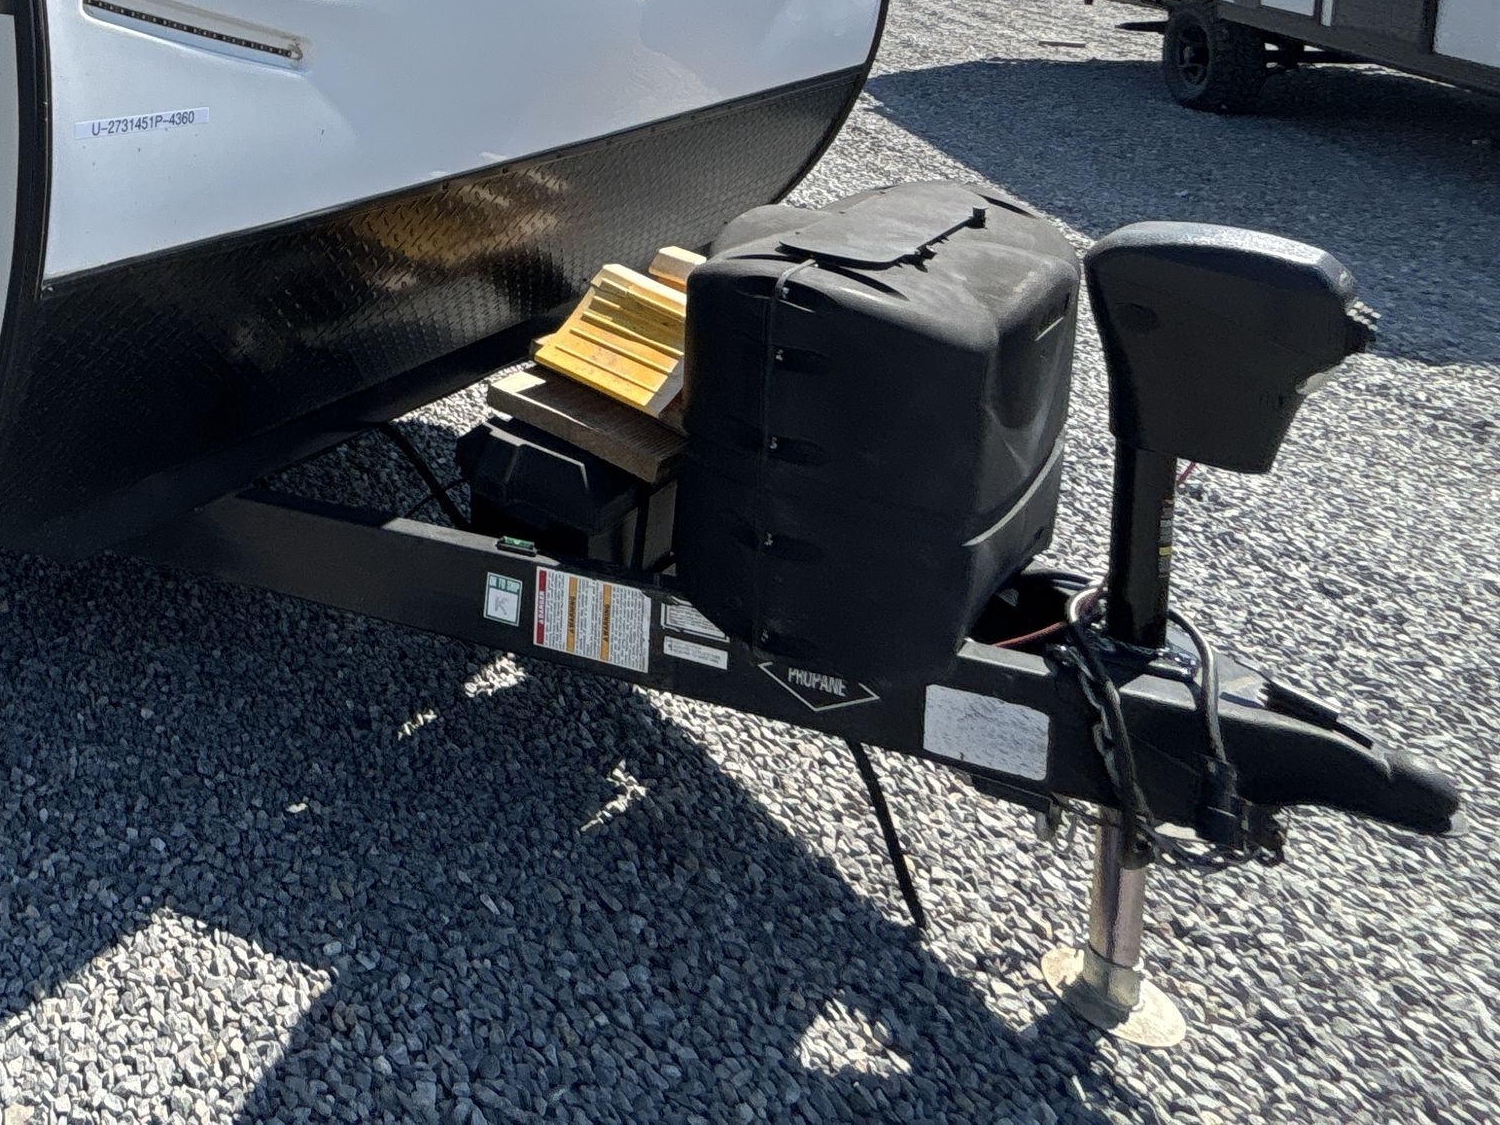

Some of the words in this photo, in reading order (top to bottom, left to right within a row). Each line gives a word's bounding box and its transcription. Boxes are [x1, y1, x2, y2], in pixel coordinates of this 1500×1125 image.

[91, 110, 195, 136] U-2731451P-4360
[569, 596, 577, 628] WARNING
[603, 603, 611, 637] WARNING
